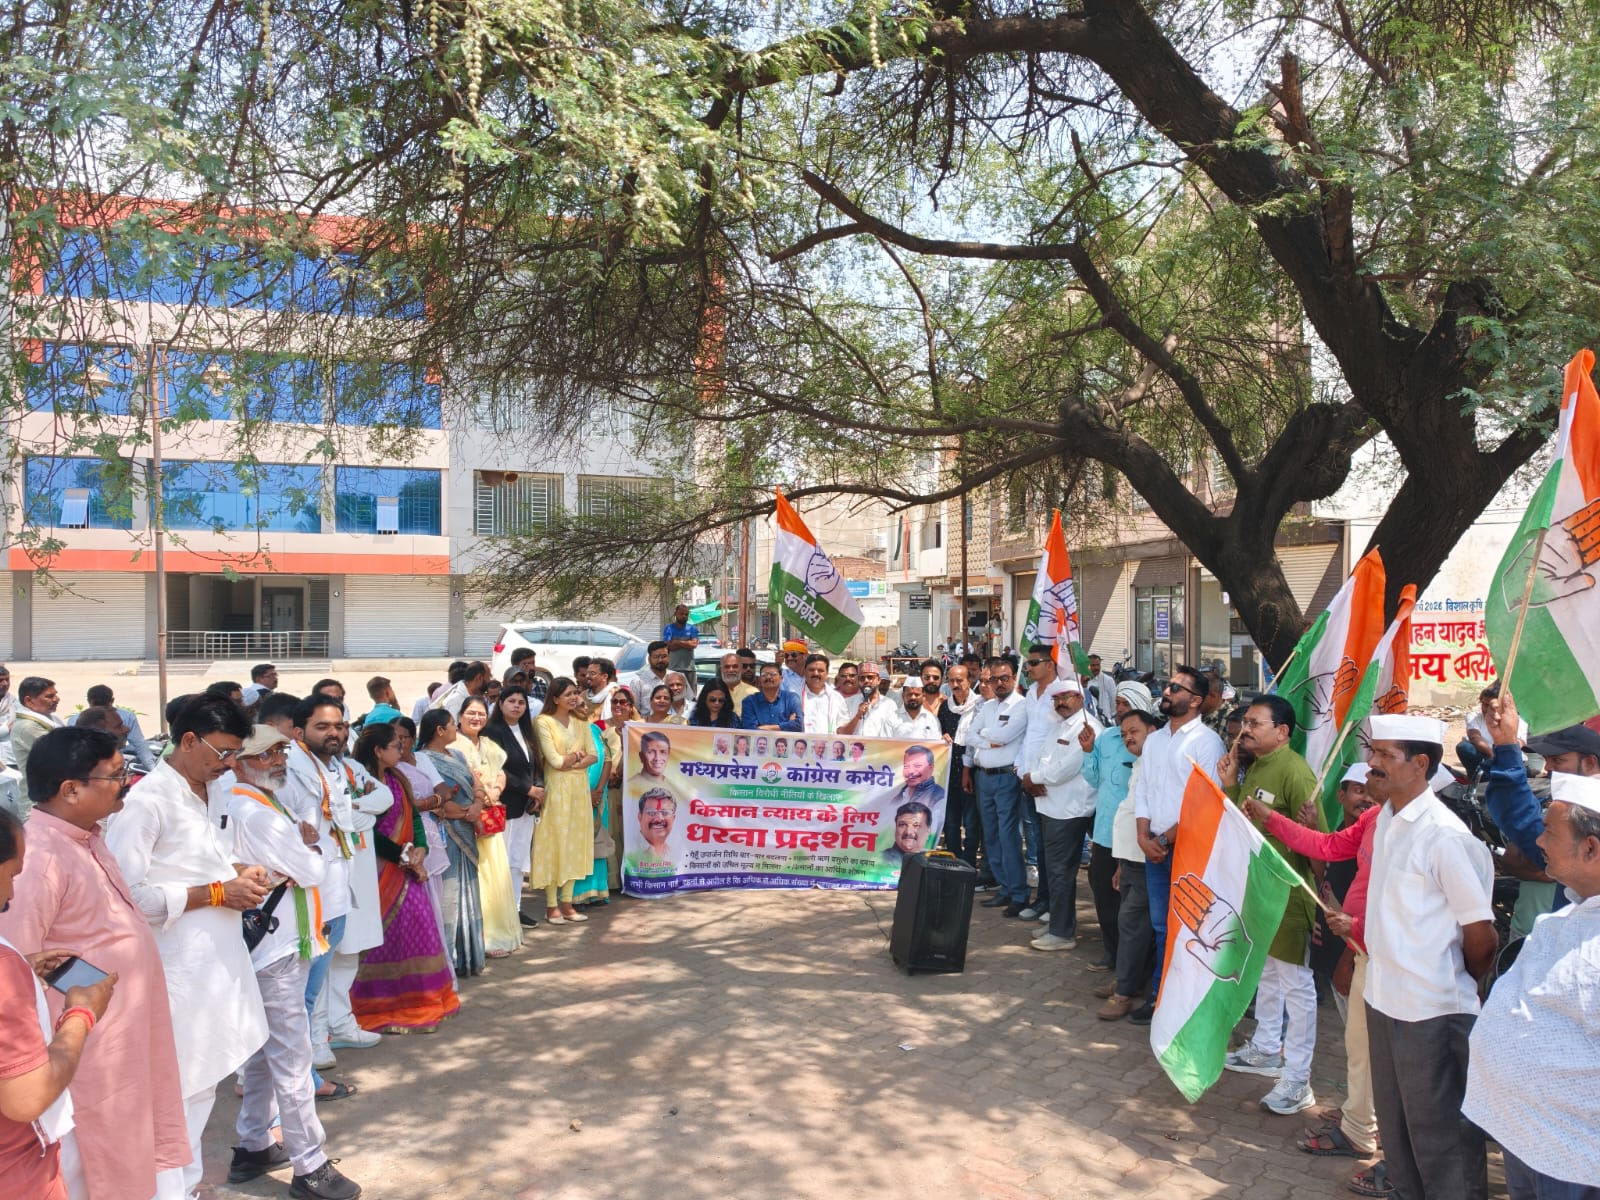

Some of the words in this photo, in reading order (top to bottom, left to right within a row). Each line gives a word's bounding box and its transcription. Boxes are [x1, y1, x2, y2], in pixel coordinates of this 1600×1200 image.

[784, 590, 825, 628] कांग्रेस
[1446, 598, 1468, 612] विशाल
[1438, 622, 1477, 647] यादव
[680, 758, 758, 780] मध्यप्रदेश
[787, 762, 841, 783] कांग्रेस
[846, 765, 895, 787] कमेटी
[690, 799, 759, 819] किसान
[763, 807, 812, 821] न्याय
[816, 804, 838, 823] के
[842, 806, 880, 826] लिए
[687, 823, 768, 848] धरना
[775, 825, 878, 852] प्रदर्शन
